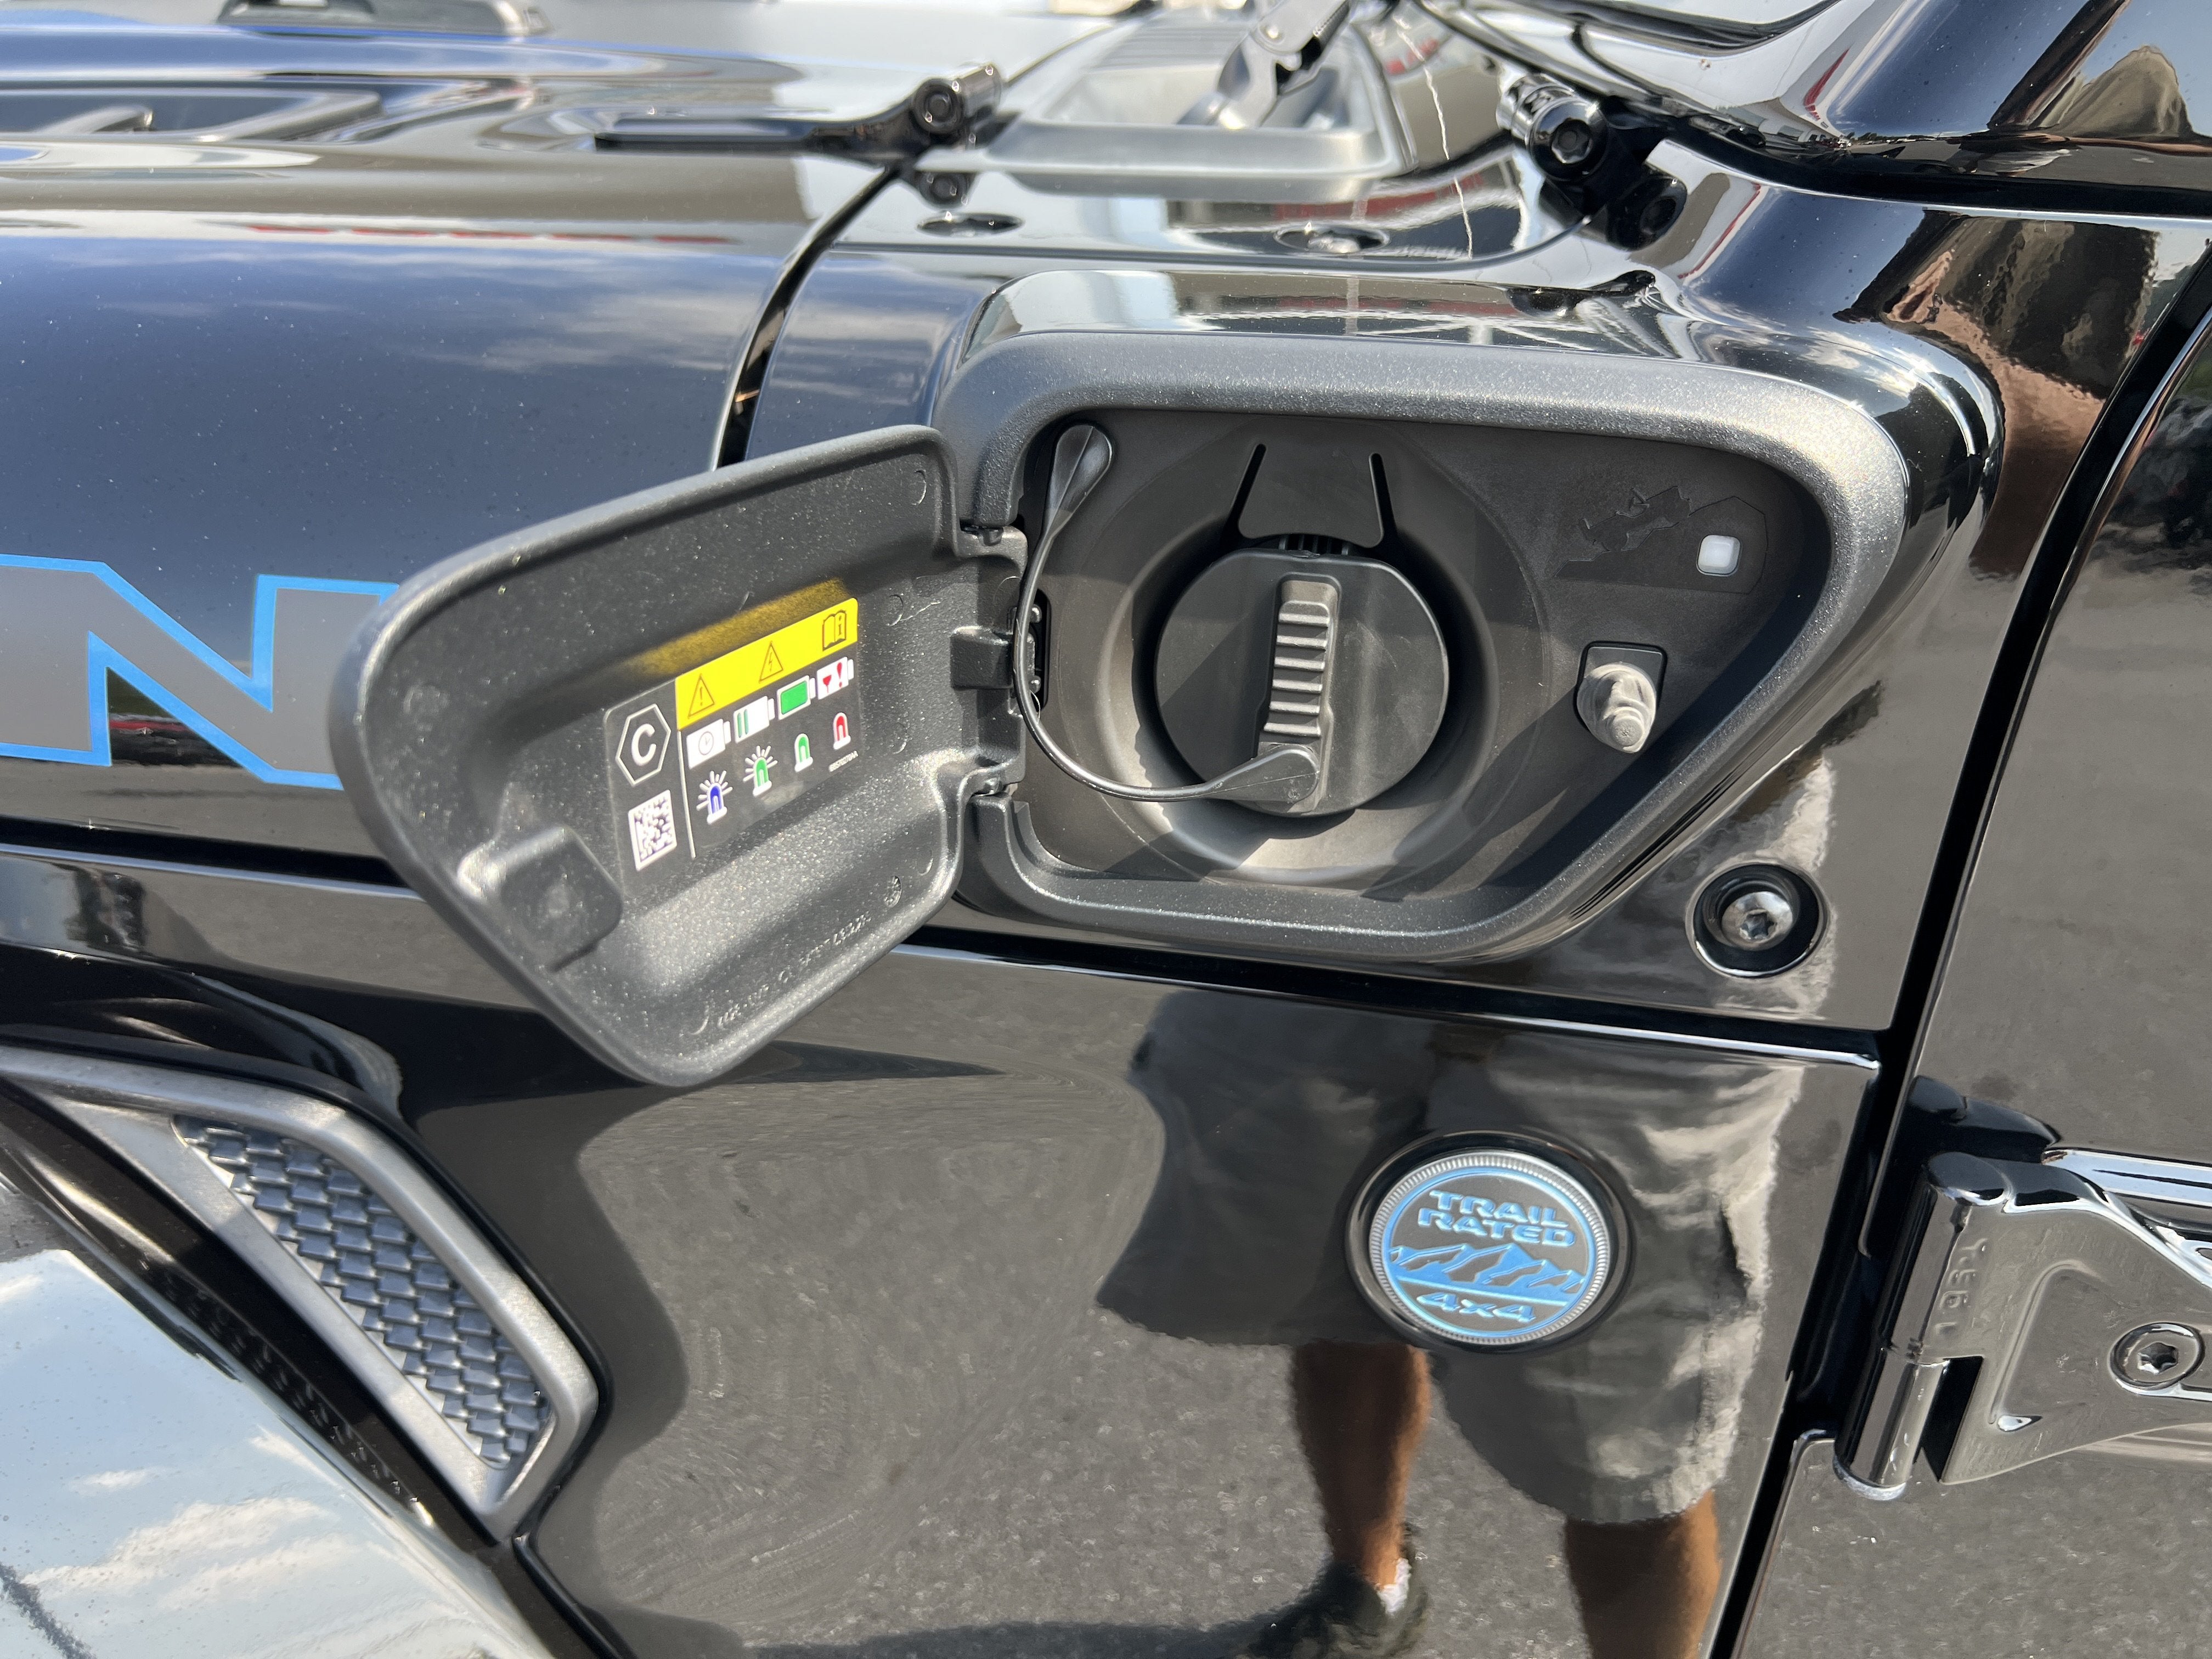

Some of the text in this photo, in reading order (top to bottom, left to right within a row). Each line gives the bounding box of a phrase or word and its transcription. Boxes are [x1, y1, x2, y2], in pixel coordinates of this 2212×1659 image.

[631, 723, 657, 766] C
[1417, 1207, 1576, 1247] RATED
[1429, 1189, 1569, 1228] TRAIL
